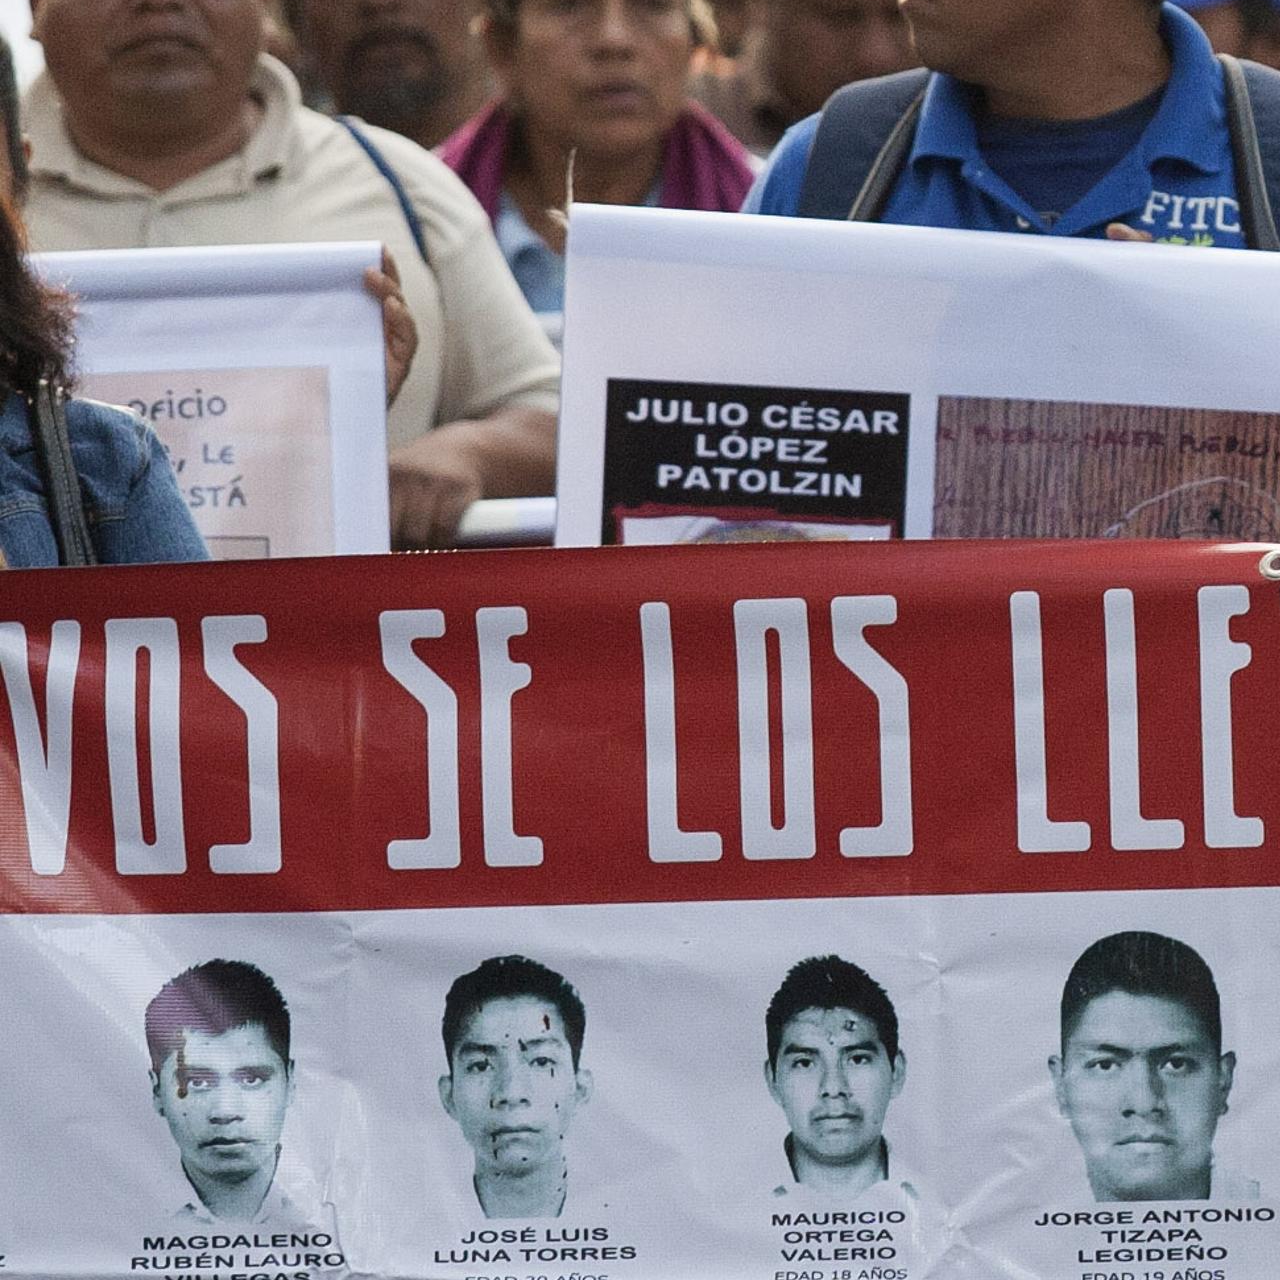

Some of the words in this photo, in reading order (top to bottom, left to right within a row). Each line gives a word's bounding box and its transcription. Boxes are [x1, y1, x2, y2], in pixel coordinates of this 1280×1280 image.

[626, 398, 749, 426] JULIO
[761, 401, 900, 435] CÉSAR
[695, 429, 829, 464] LÓPEZ
[656, 463, 863, 498] PATOLZIN
[182, 474, 247, 508] STÁ
[379, 606, 544, 871] SE
[640, 594, 914, 863] LOS
[772, 1211, 906, 1227] MAURICIO
[1035, 1212, 1134, 1227] JORGE
[1142, 1208, 1275, 1224] ANTONIO
[144, 1234, 333, 1251] MAGDALENO
[462, 1227, 537, 1245] JOSÉ
[546, 1228, 609, 1243] LUIS
[784, 1229, 894, 1245] ORTEGA
[1101, 1229, 1203, 1244] TIZAPA
[131, 1252, 239, 1270] RUBÉN
[245, 1253, 347, 1268] LAURO
[435, 1249, 512, 1264] LUNA
[520, 1246, 637, 1262] TORRES
[781, 1247, 897, 1262] VALERIO
[1078, 1245, 1228, 1264] LEGIDEÑO
